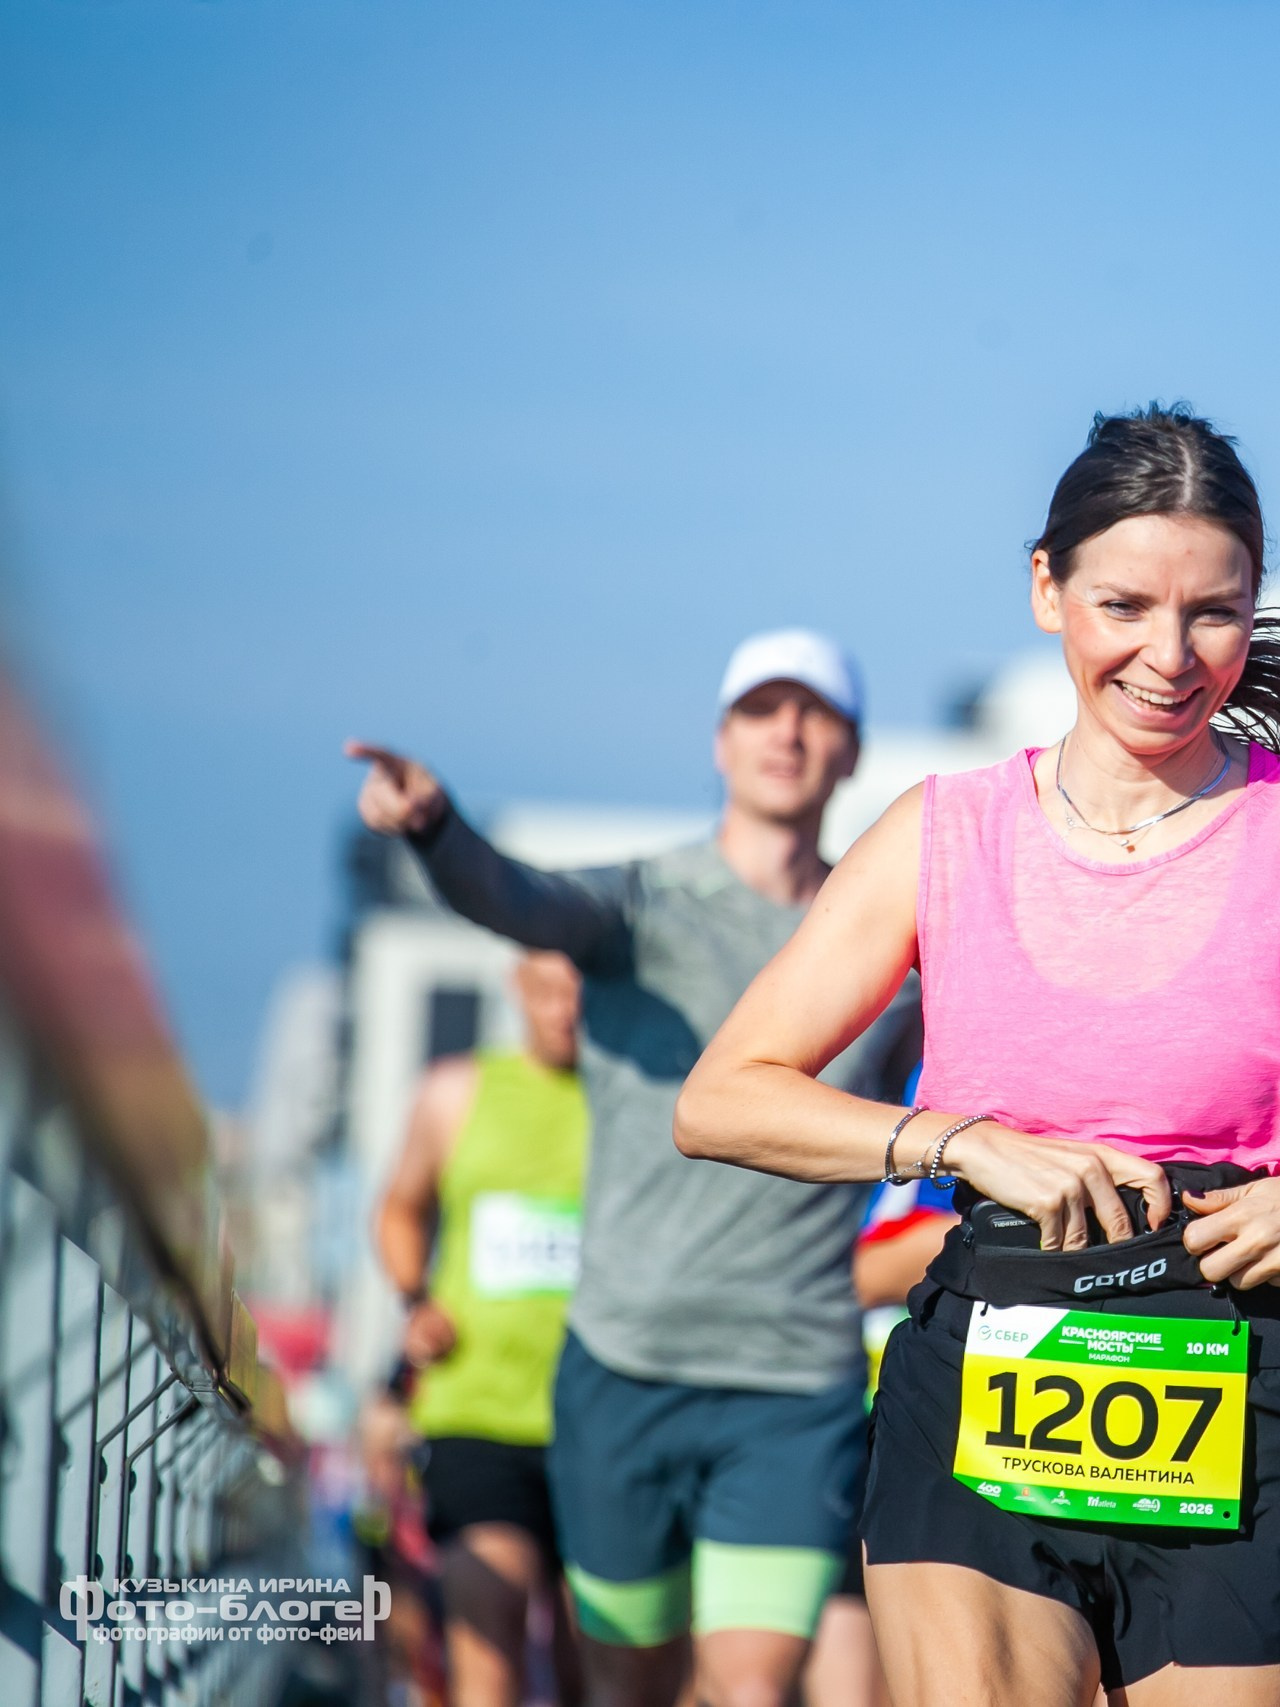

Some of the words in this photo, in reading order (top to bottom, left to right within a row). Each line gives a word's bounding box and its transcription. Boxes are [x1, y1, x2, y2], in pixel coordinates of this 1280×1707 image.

[995, 1330, 1029, 1343] СБЕР
[1061, 1325, 1162, 1345] КРАСНОЯРСКИЕ
[1087, 1340, 1134, 1354] МОСТЫ
[1186, 1342, 1204, 1355] 10
[1206, 1343, 1229, 1356] КМ
[1088, 1353, 1130, 1363] МАРАФОН
[985, 1371, 1223, 1463] 1207
[1001, 1457, 1086, 1478] ТРУСКОВА
[1090, 1464, 1195, 1485] ВАЛЕНТИНА
[1179, 1502, 1214, 1515] 2026
